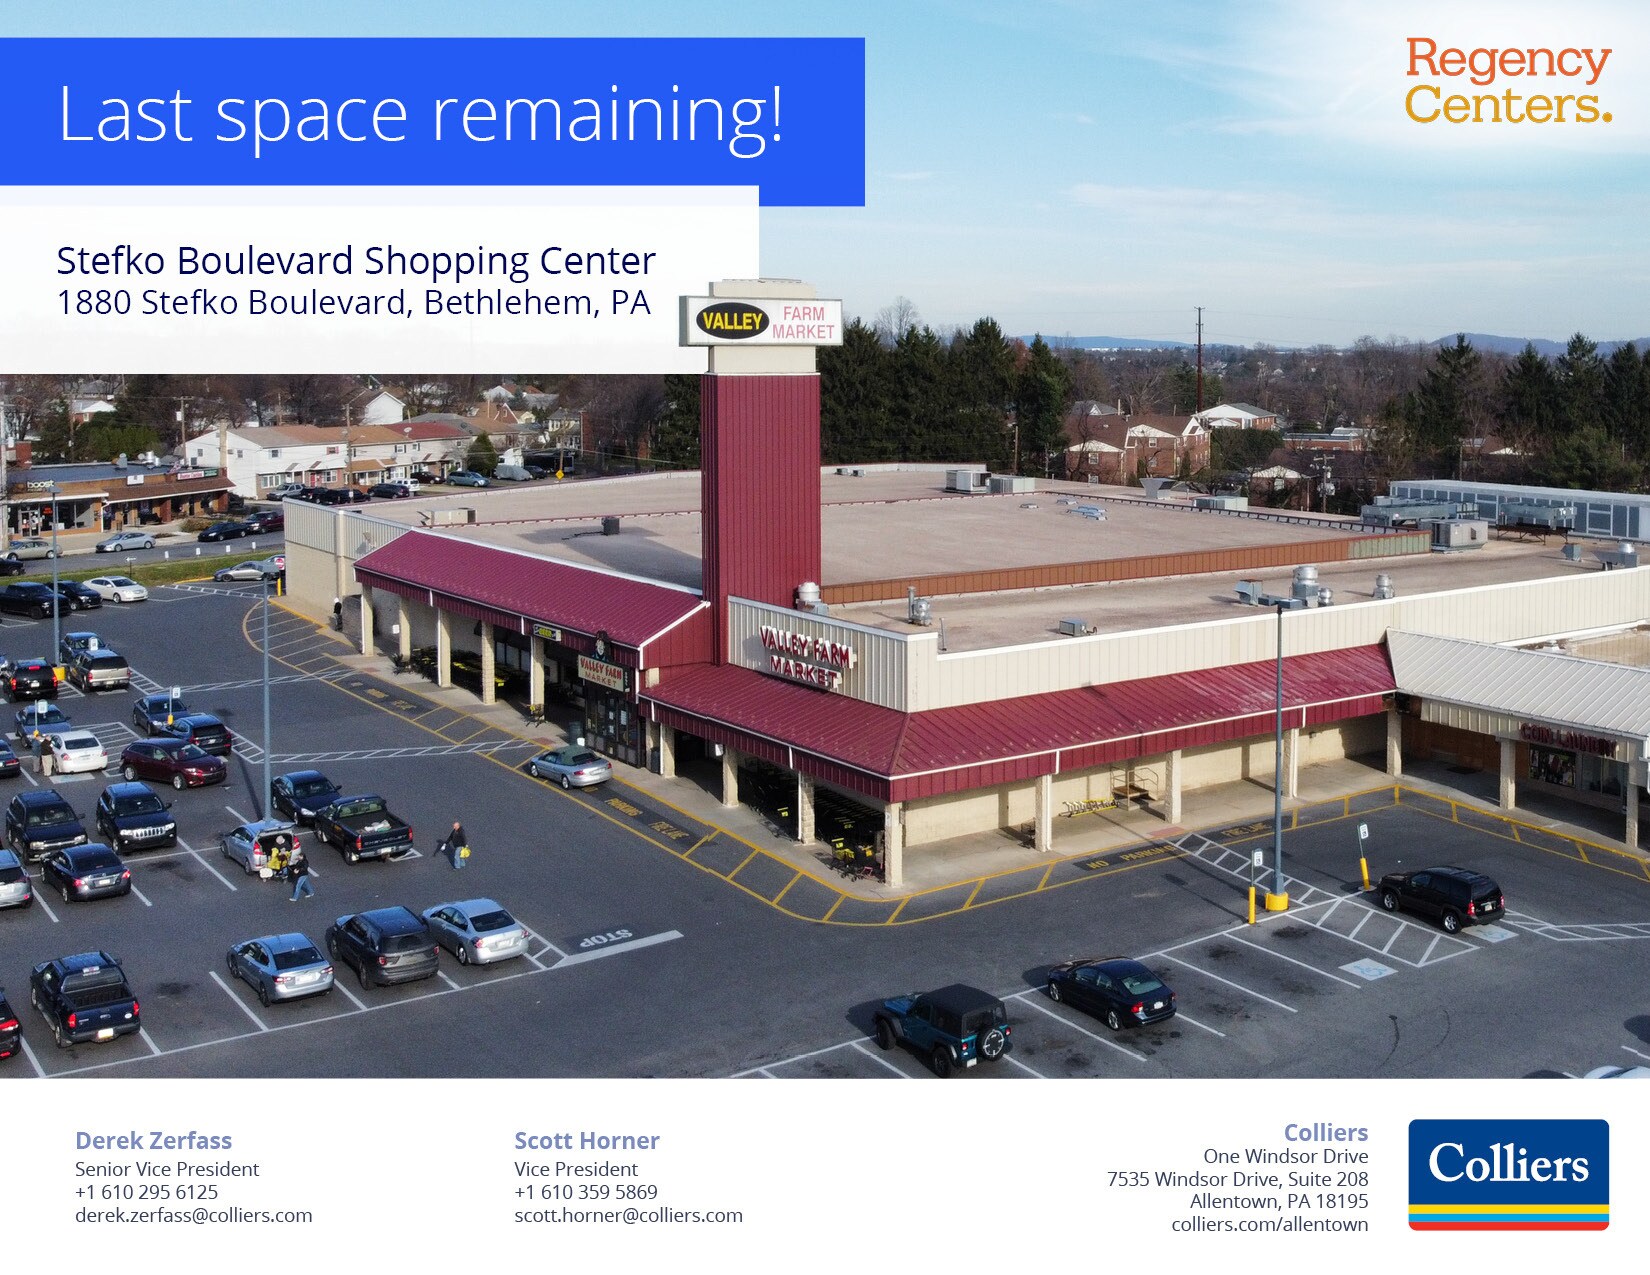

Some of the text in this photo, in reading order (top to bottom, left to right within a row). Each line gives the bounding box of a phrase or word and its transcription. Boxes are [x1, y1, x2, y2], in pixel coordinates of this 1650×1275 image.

[703, 312, 763, 330] VALLEY
[784, 306, 824, 321] FARM
[773, 324, 834, 339] MARKET
[760, 625, 856, 669] VALLEY FARM
[580, 658, 604, 674] VALLEY
[605, 665, 622, 680] FARM
[585, 671, 617, 687] MARKET
[769, 655, 842, 689] MARKET
[1520, 723, 1552, 745] COIN
[1086, 860, 1110, 869] NO
[1120, 845, 1176, 861] PARKING
[580, 929, 633, 948] STOP
